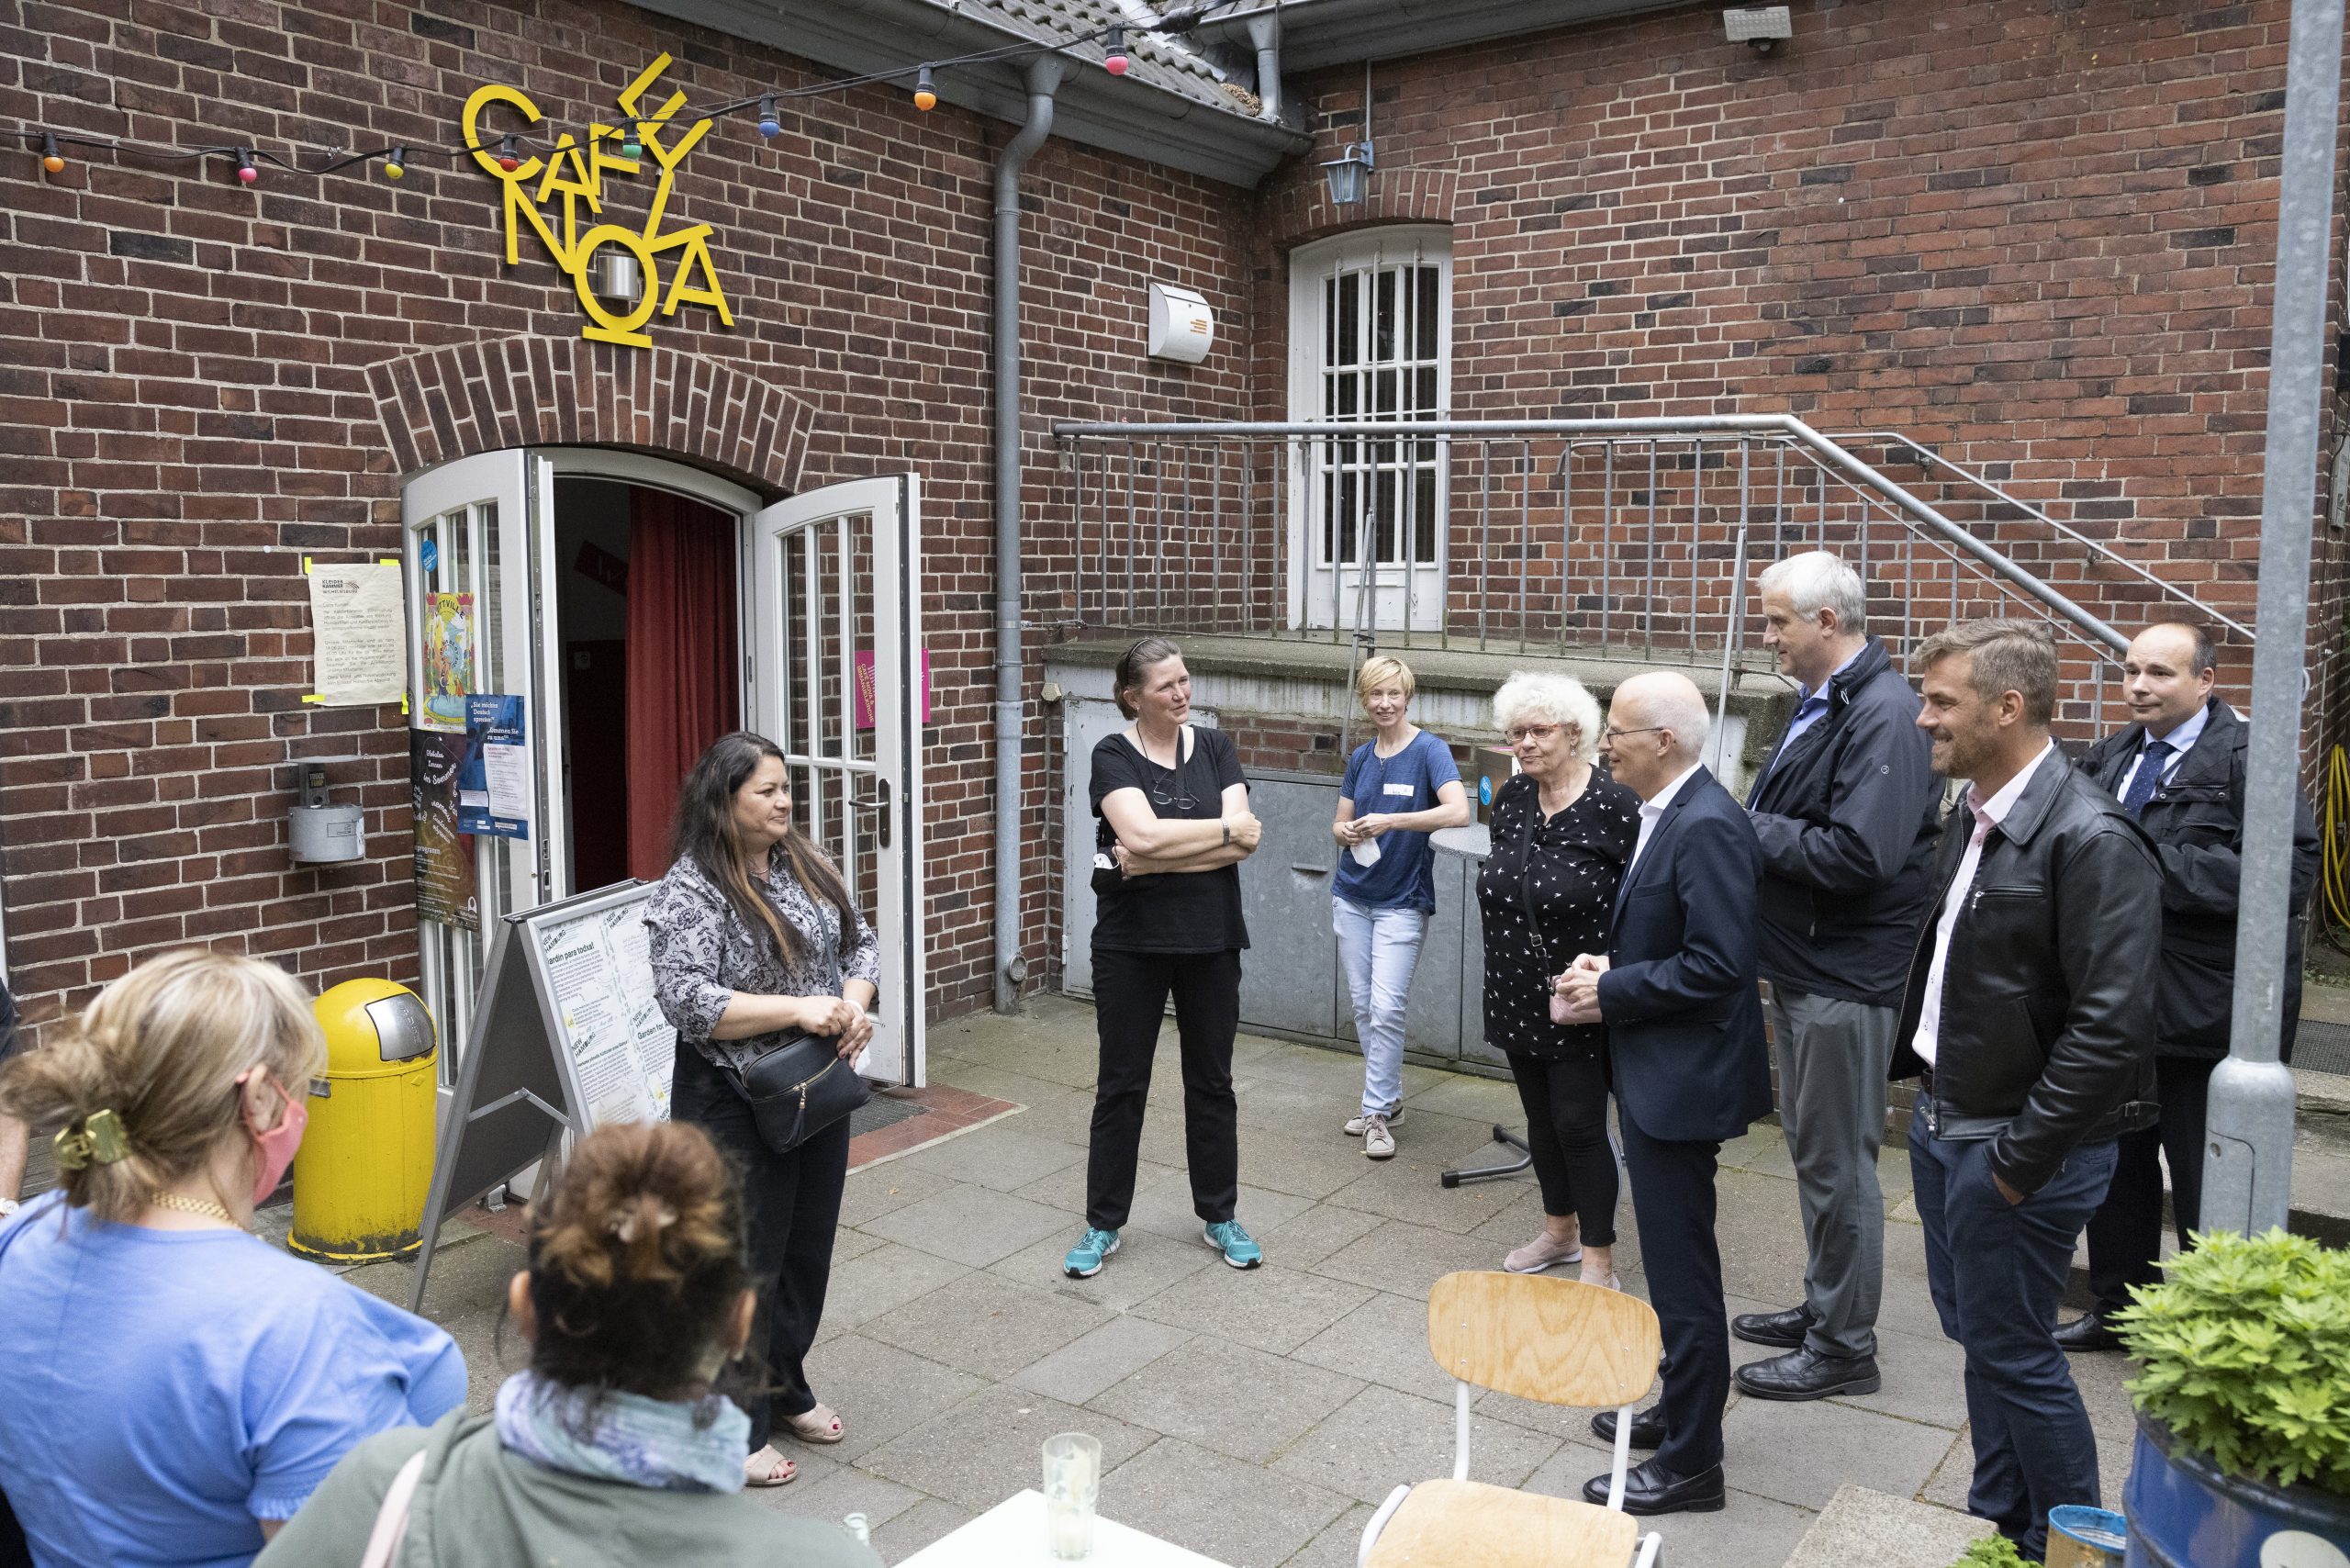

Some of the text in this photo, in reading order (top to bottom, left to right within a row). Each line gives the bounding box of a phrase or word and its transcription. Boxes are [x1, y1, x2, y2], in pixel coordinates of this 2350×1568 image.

[605, 909, 617, 924] NEW
[609, 908, 629, 928] HAMBURG
[544, 929, 566, 954] HAMBURG
[564, 947, 577, 961] para
[632, 1010, 643, 1024] NEW
[635, 1004, 655, 1029] HAMBURG
[637, 1026, 656, 1040] Garden
[655, 1022, 665, 1034] for
[571, 1037, 583, 1052] NEW
[574, 1031, 597, 1058] HAMBURG
